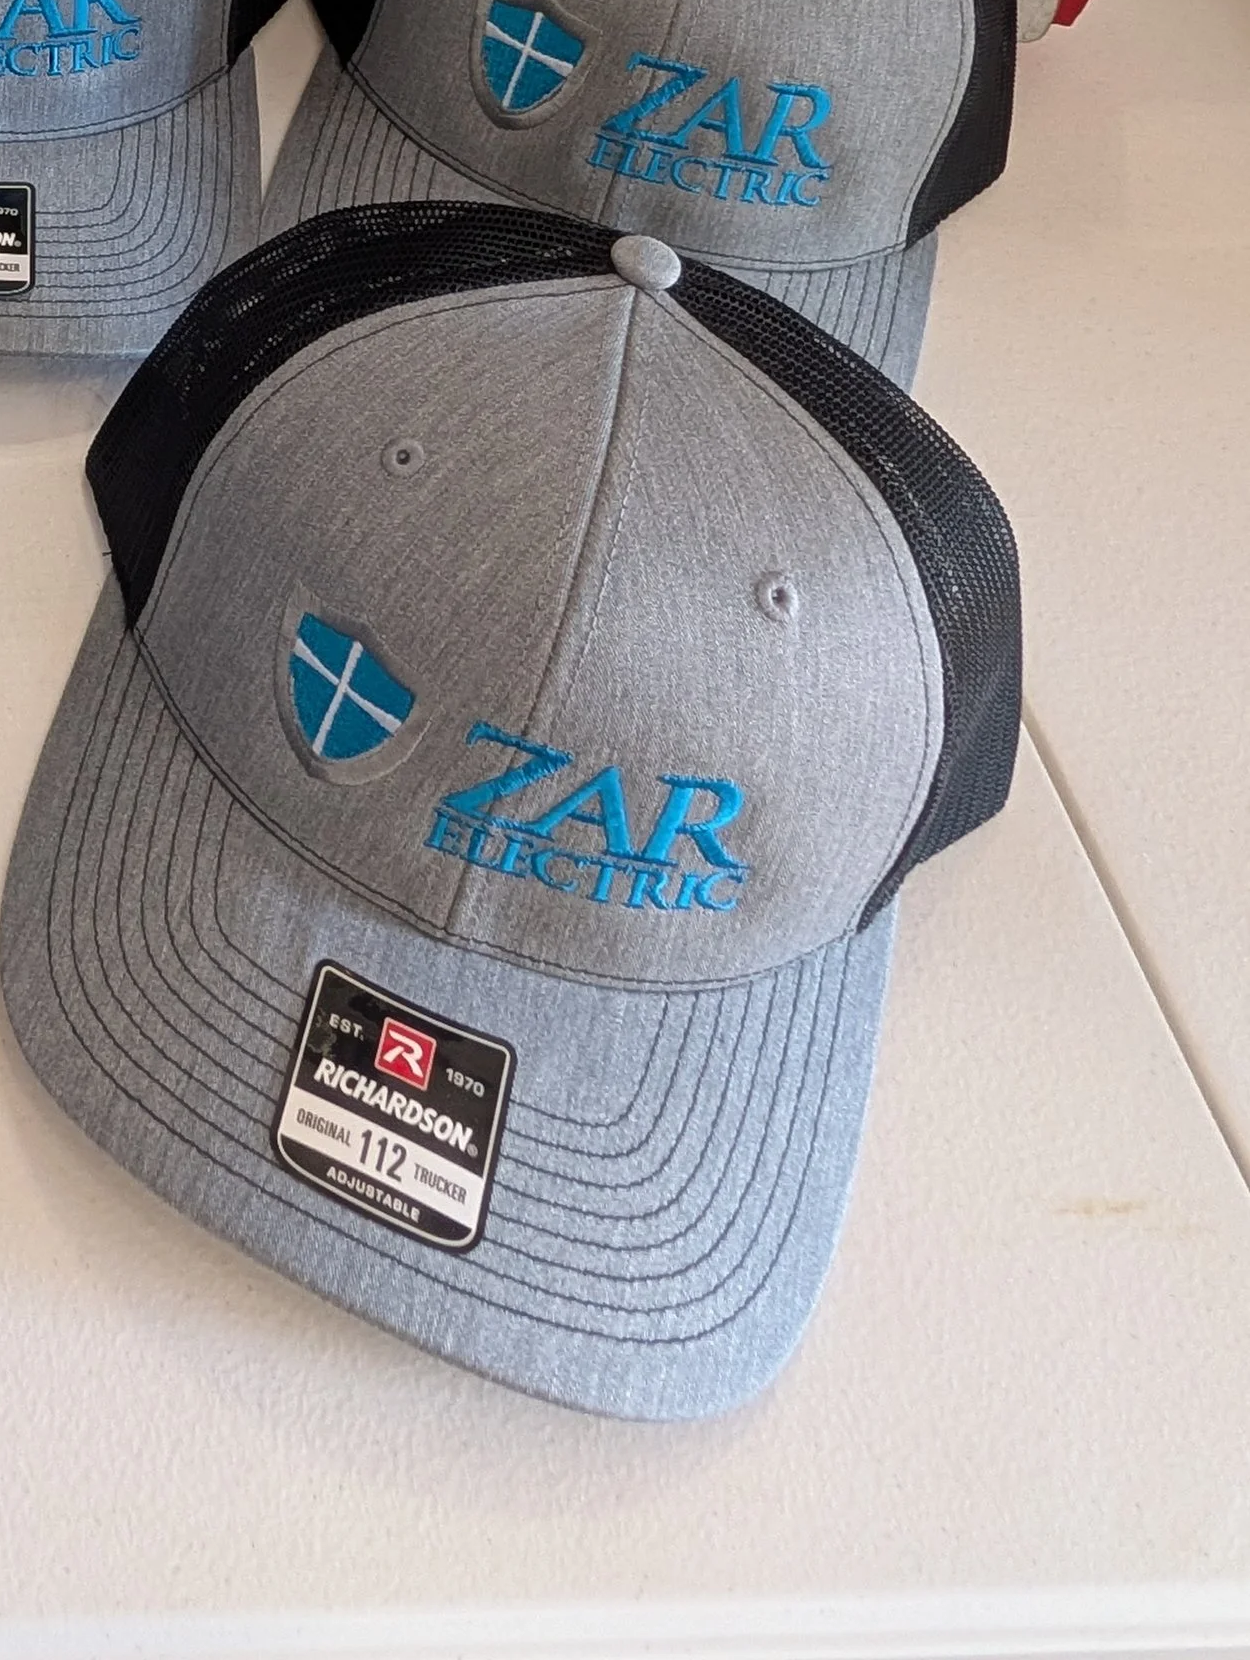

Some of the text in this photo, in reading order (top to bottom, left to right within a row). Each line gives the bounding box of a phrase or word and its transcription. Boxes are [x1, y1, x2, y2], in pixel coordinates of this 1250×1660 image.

[596, 50, 836, 170] ZAR
[585, 130, 835, 207] ELECTRIC
[441, 722, 750, 868] ZAR
[422, 806, 747, 911] ELECTRIC
[328, 1012, 365, 1041] EST.
[445, 1067, 486, 1098] 1970
[296, 1107, 467, 1206] ORIGINAL 112 TRUCKER
[326, 1165, 422, 1223] ADJUSTABLE
